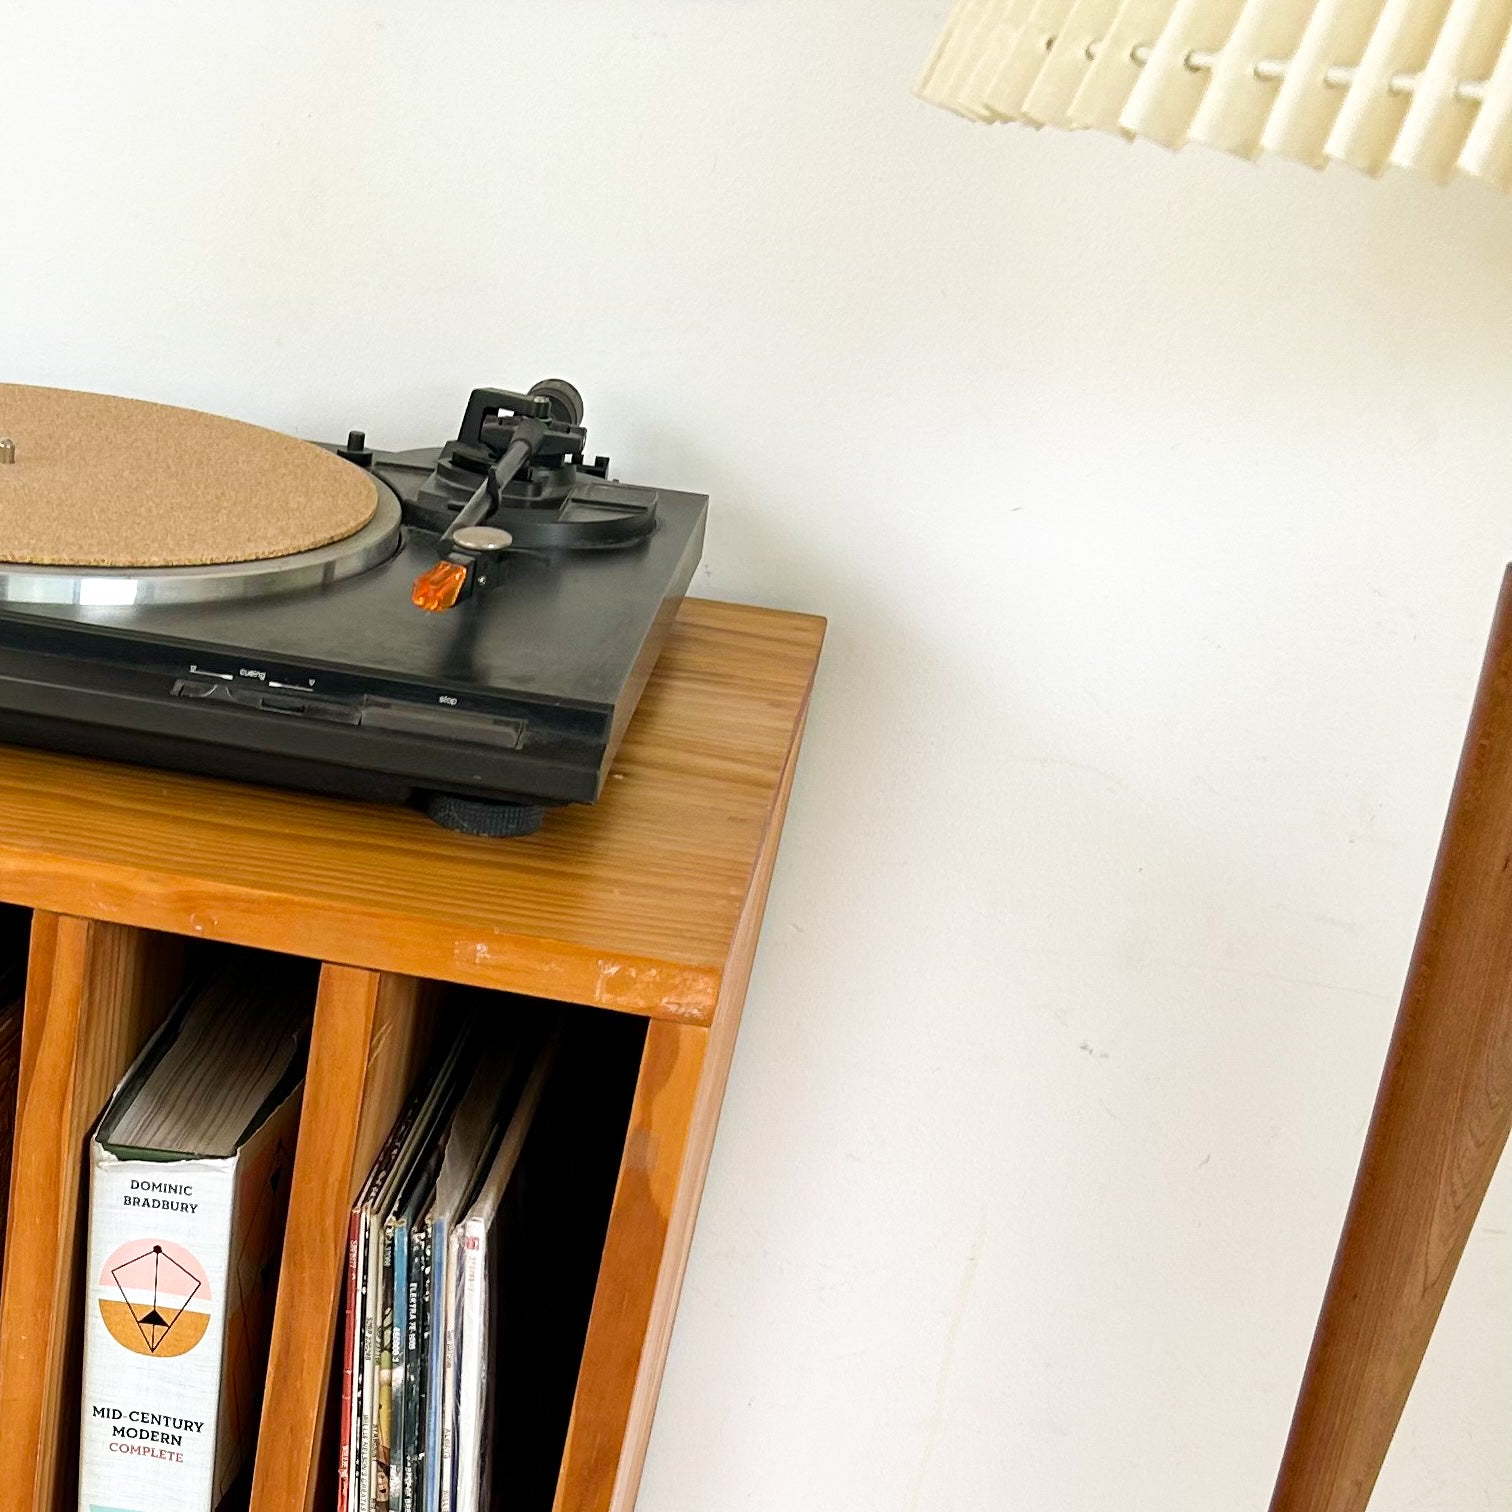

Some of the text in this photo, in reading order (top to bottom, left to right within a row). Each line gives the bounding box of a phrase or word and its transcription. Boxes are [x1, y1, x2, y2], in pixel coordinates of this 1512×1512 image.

[130, 1180, 192, 1196] DOMINIC
[124, 1196, 198, 1214] BRADBURY
[409, 1282, 417, 1319] ELEKTRA
[92, 1406, 204, 1433] MID-CENTURY
[112, 1426, 182, 1446] MODERN
[109, 1443, 184, 1463] COMPLETE
